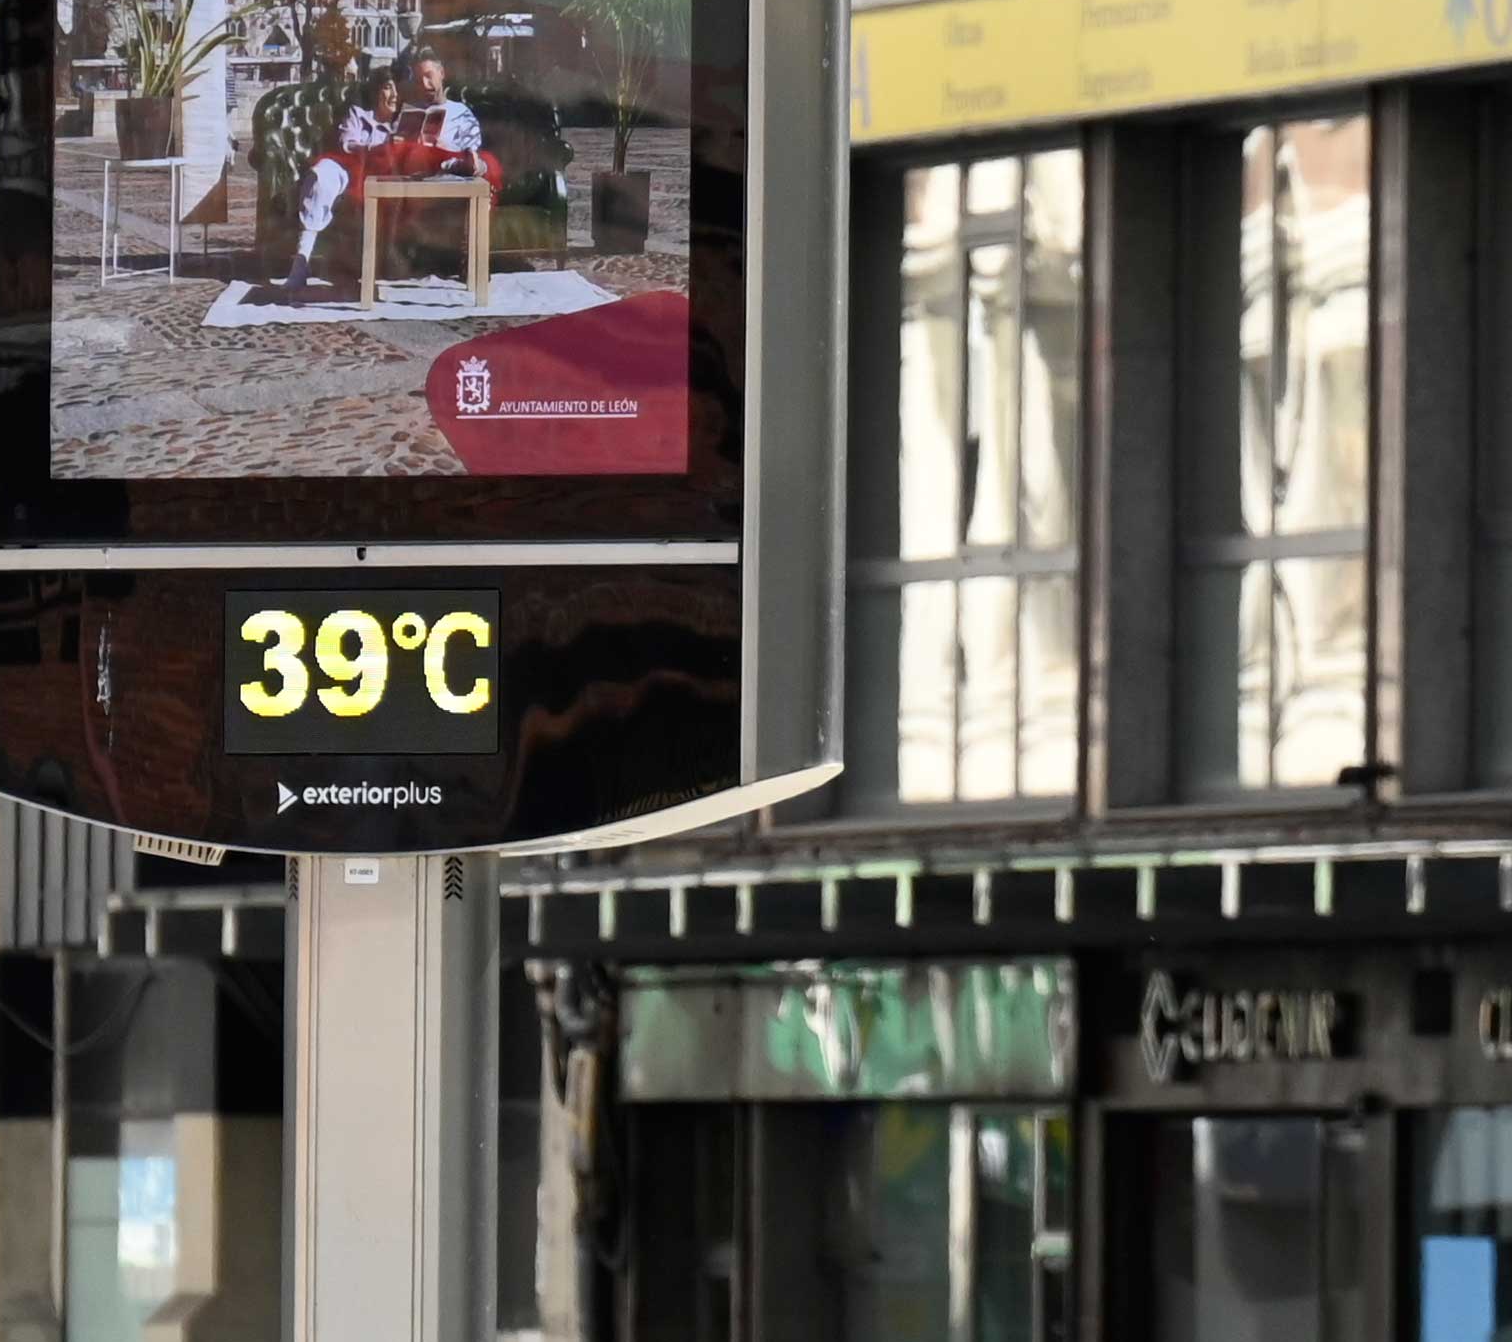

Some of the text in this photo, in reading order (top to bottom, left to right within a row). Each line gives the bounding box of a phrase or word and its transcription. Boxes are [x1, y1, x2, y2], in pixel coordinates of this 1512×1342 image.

[499, 397, 637, 413] AYUNTAMIENTO DE LEÓN
[239, 609, 490, 717] 39°C
[302, 780, 442, 809] exteriorplus
